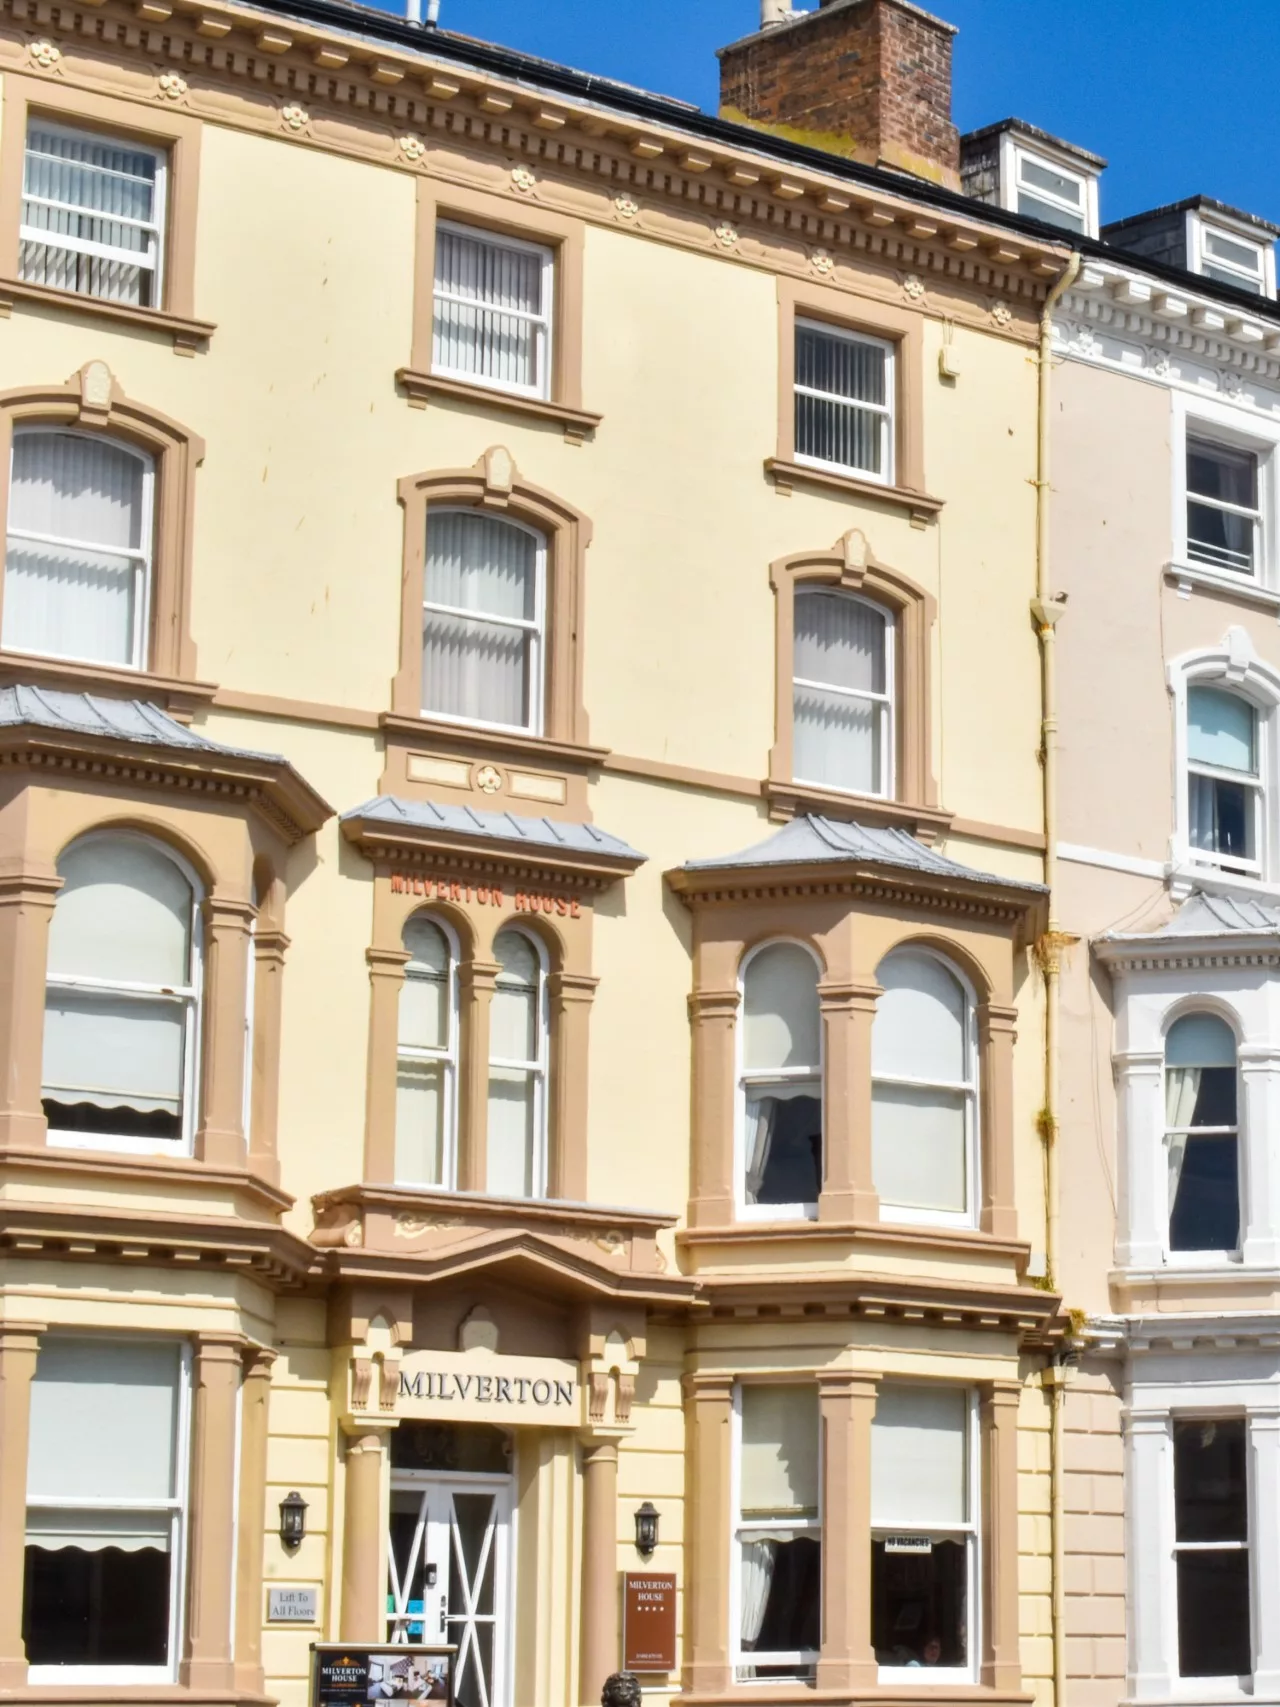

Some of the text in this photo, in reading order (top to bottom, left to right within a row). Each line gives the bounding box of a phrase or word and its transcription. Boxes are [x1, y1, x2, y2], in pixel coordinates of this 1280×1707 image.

[390, 872, 582, 919] MILVERTON HOUSE
[397, 1370, 576, 1407] MILVERTON
[897, 1537, 929, 1546] VACANCIES
[629, 1580, 673, 1590] MILVERTON
[279, 1592, 308, 1602] Lift To
[638, 1592, 664, 1602] HOUSE
[272, 1606, 314, 1616] All Floors
[322, 1667, 366, 1675] MILVERTON
